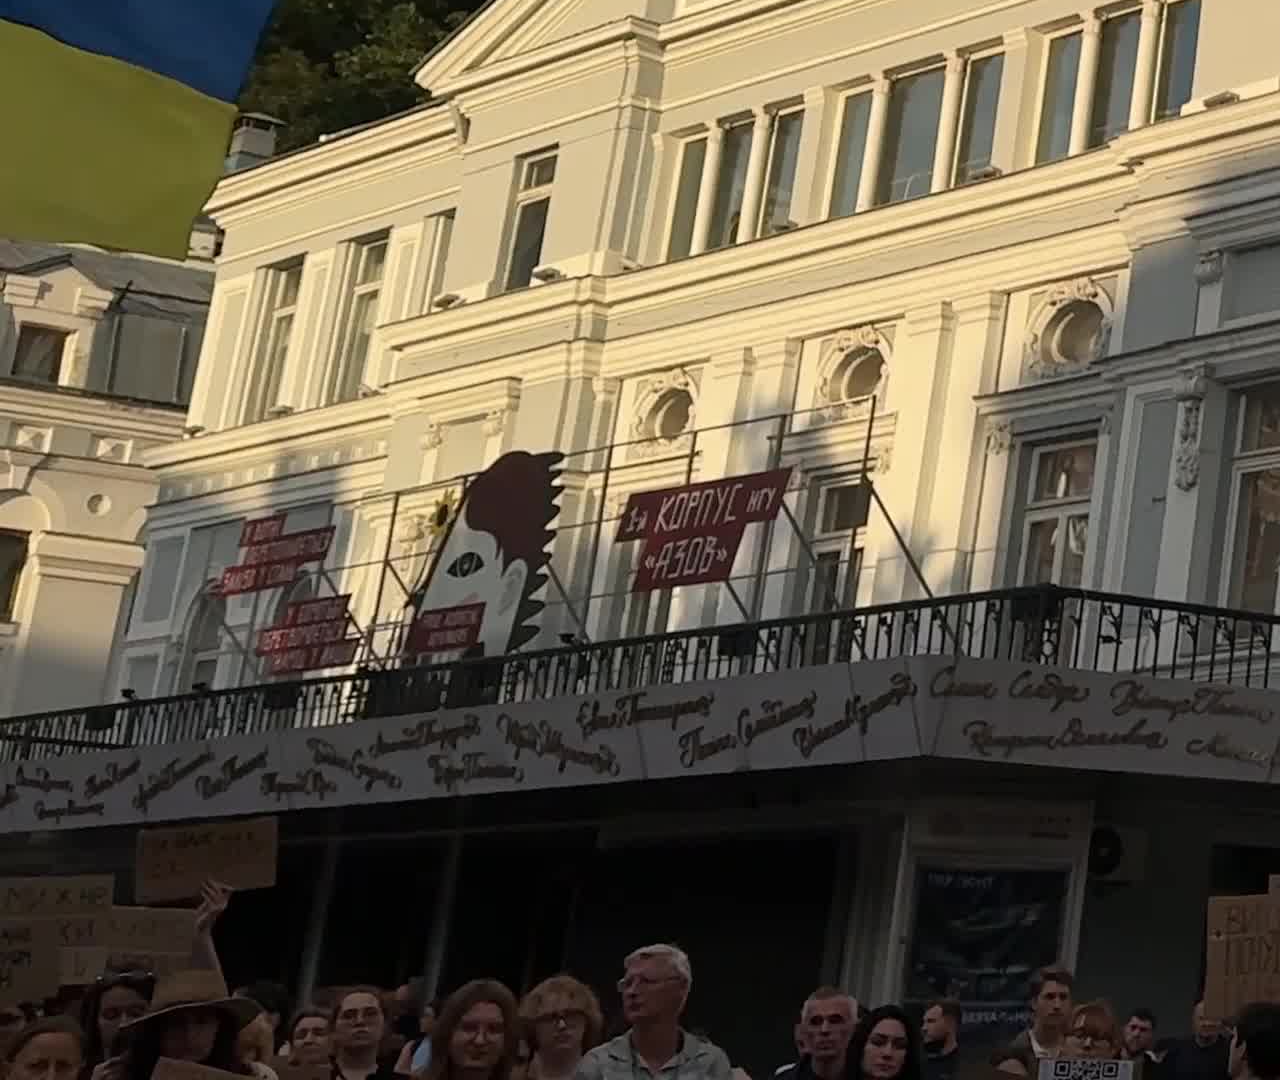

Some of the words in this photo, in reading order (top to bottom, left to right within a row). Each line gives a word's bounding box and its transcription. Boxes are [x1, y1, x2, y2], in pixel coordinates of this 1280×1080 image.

[655, 482, 743, 533] КОРПУС
[746, 487, 777, 512] НГУ
[645, 535, 729, 581] «АЗОВ»
